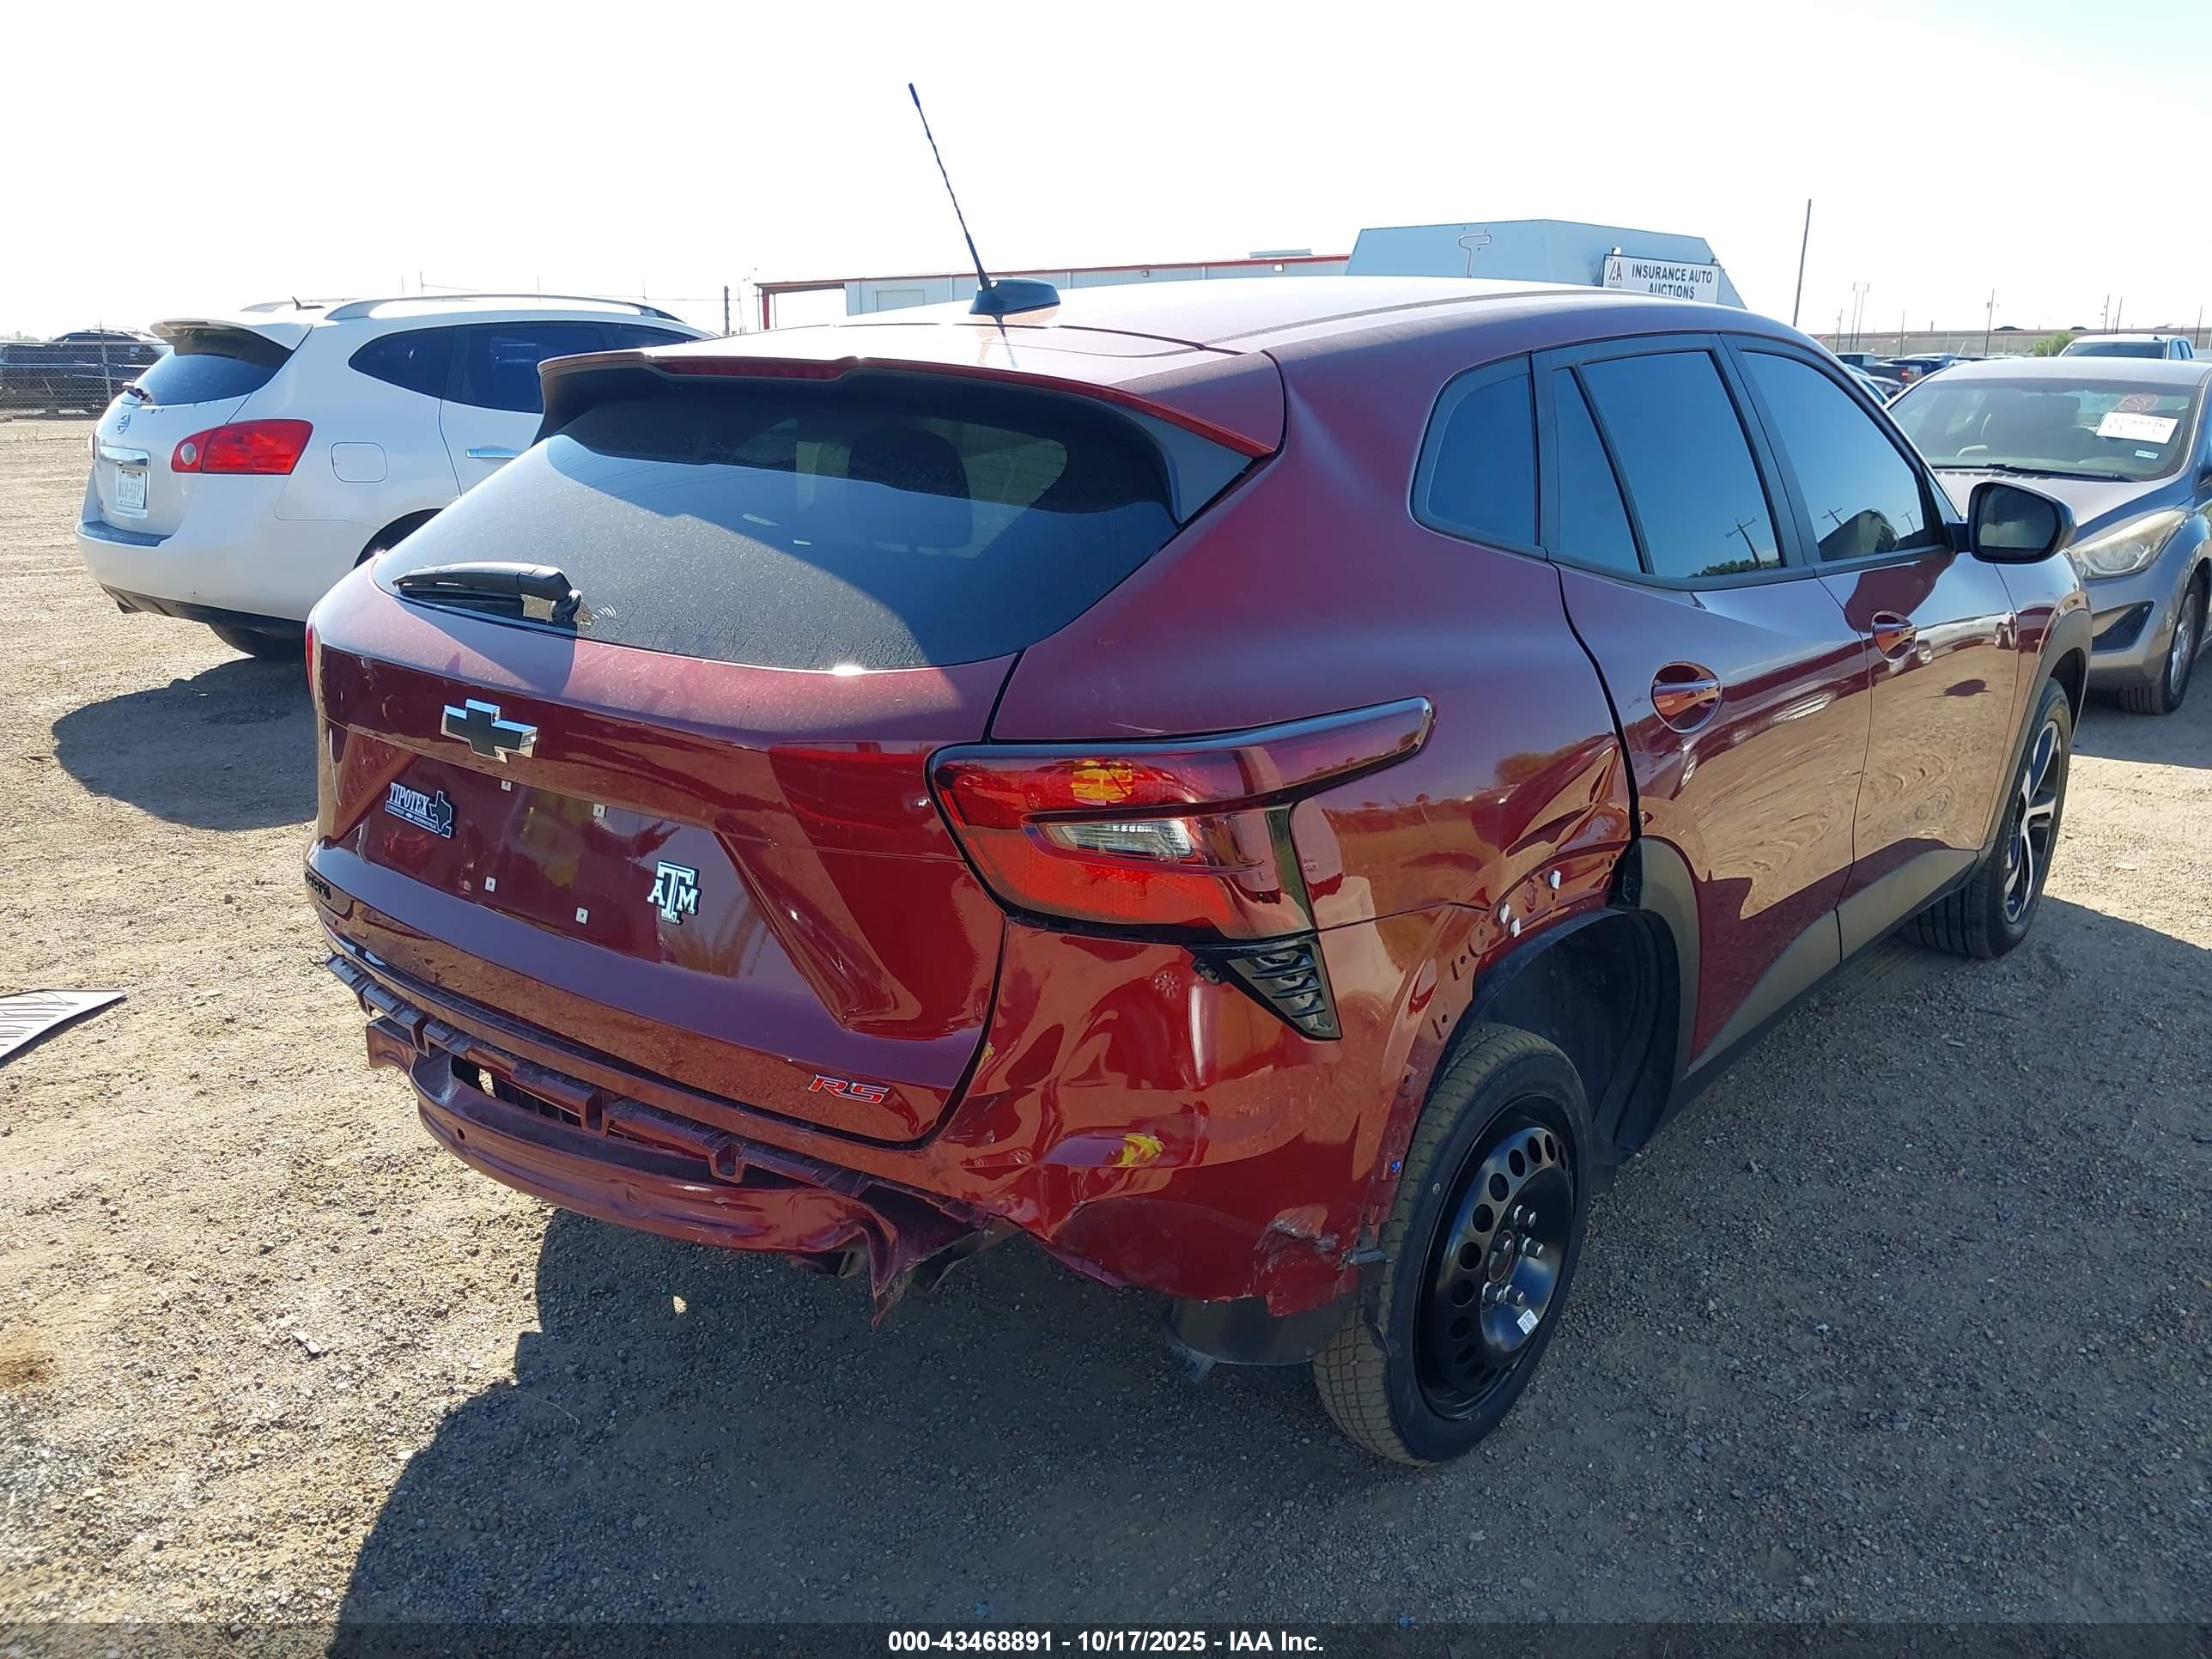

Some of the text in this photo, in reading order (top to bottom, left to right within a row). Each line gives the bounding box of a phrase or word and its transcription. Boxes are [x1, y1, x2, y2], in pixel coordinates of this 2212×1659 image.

[1632, 264, 1712, 283] INSURANCE AUTO
[1648, 283, 1695, 300] AUCTIONS
[390, 782, 430, 816] TIPOTEX
[807, 1073, 890, 1103] RS
